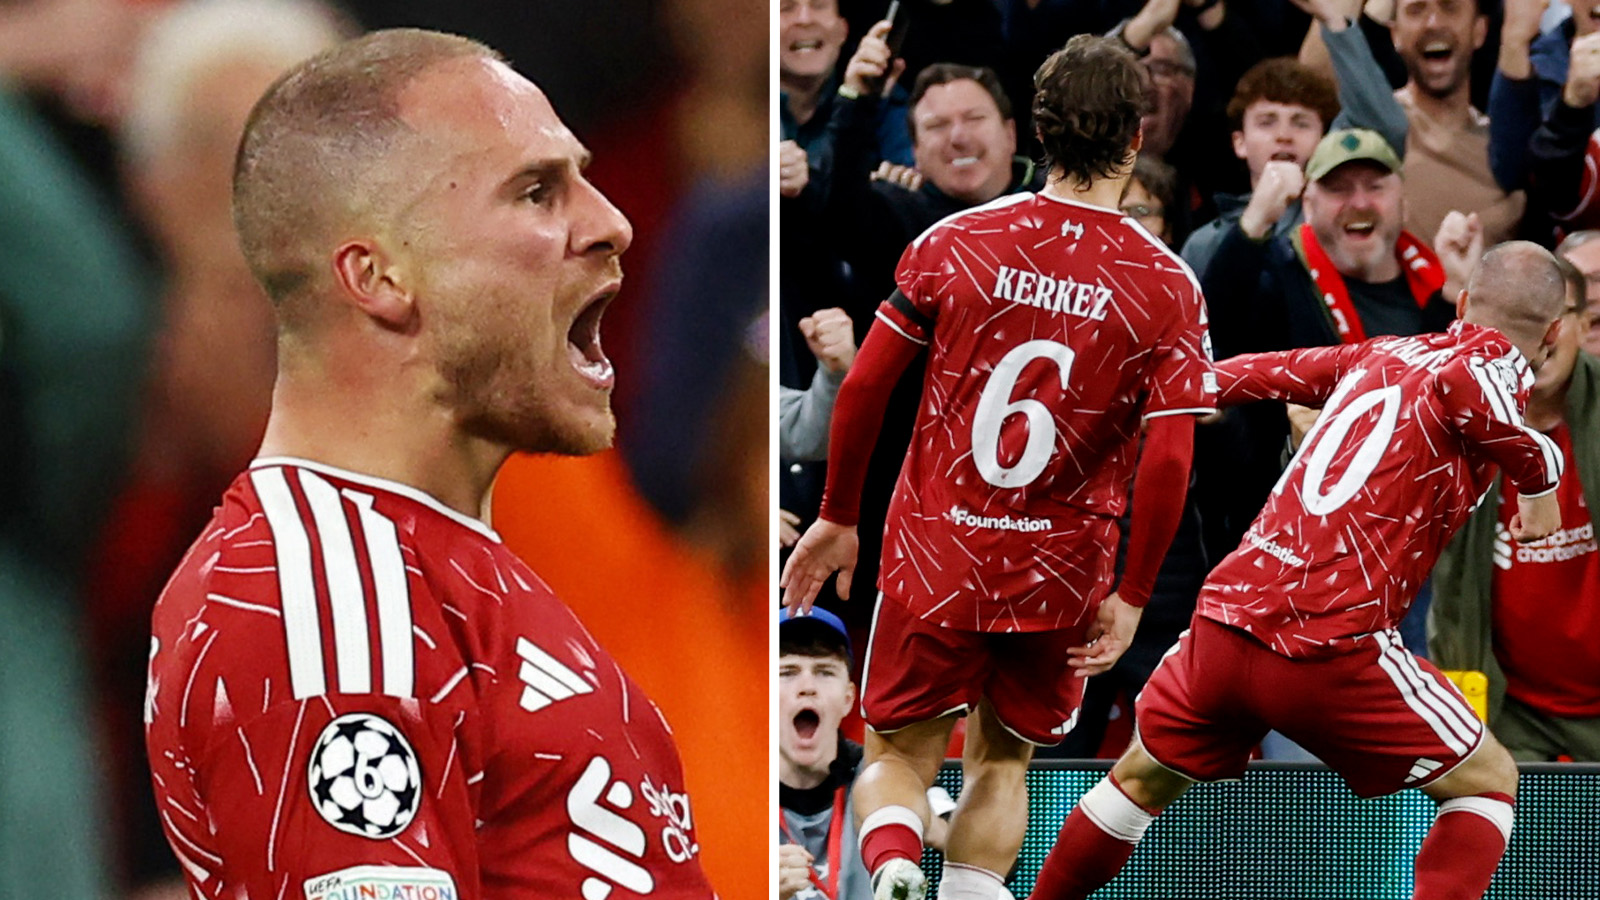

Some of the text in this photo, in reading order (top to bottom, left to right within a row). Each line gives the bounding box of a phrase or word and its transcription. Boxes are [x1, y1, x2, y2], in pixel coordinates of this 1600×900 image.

[993, 265, 1113, 321] KERKEZ
[971, 339, 1075, 489] 6
[1272, 367, 1402, 516] 10
[955, 509, 1052, 532] Foundation
[1516, 522, 1593, 547] dard
[1246, 523, 1305, 567] Fdation
[354, 750, 384, 800] 6
[309, 876, 341, 895] UEFA
[311, 884, 451, 900] OUNDATION
